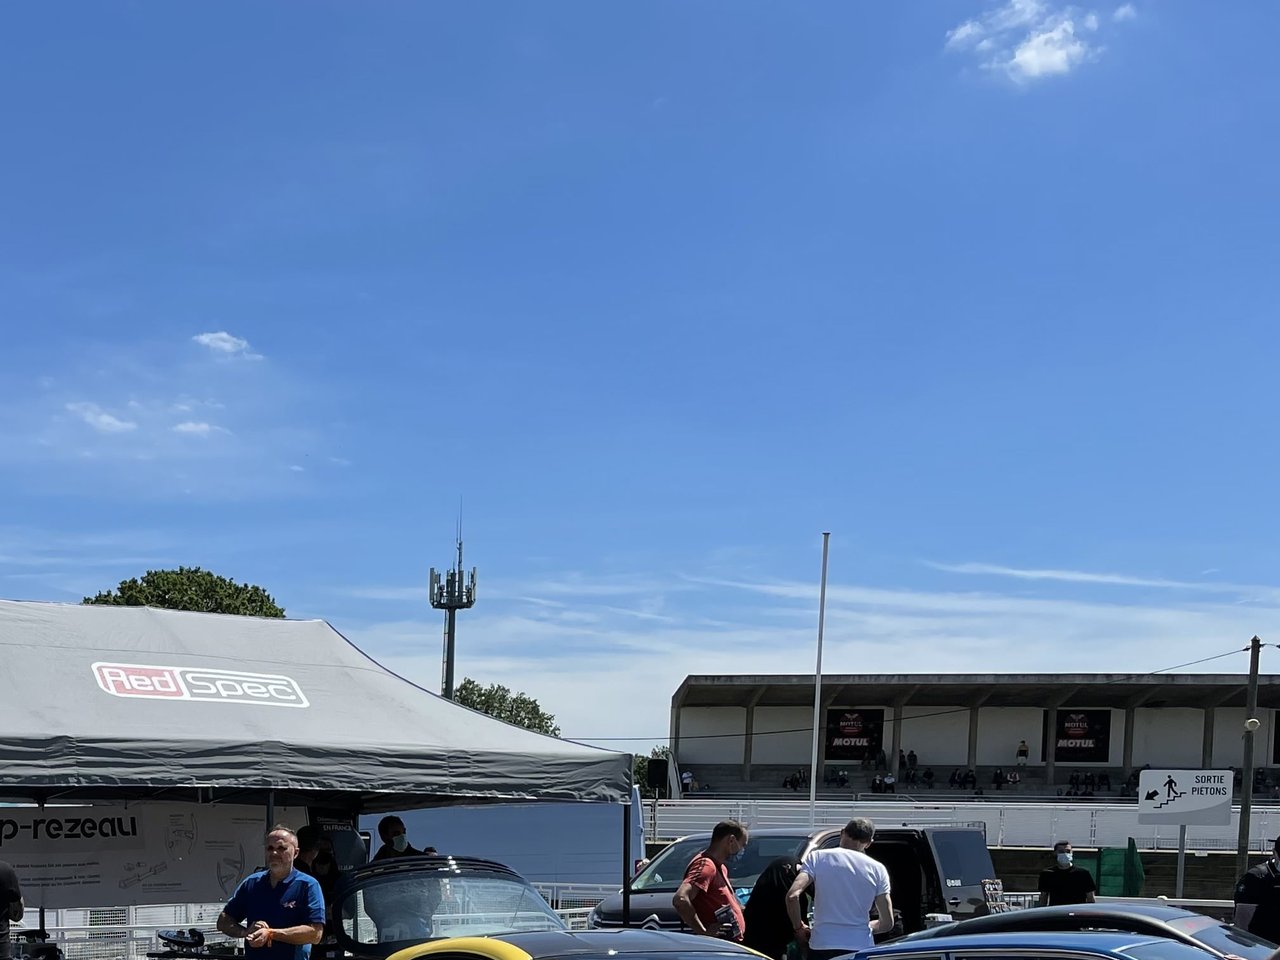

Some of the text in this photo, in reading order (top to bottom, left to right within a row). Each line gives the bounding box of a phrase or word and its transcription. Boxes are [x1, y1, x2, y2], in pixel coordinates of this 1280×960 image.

[832, 737, 869, 746] MOTUL
[1057, 739, 1094, 748] MOTUL
[1194, 775, 1225, 784] SORTIE
